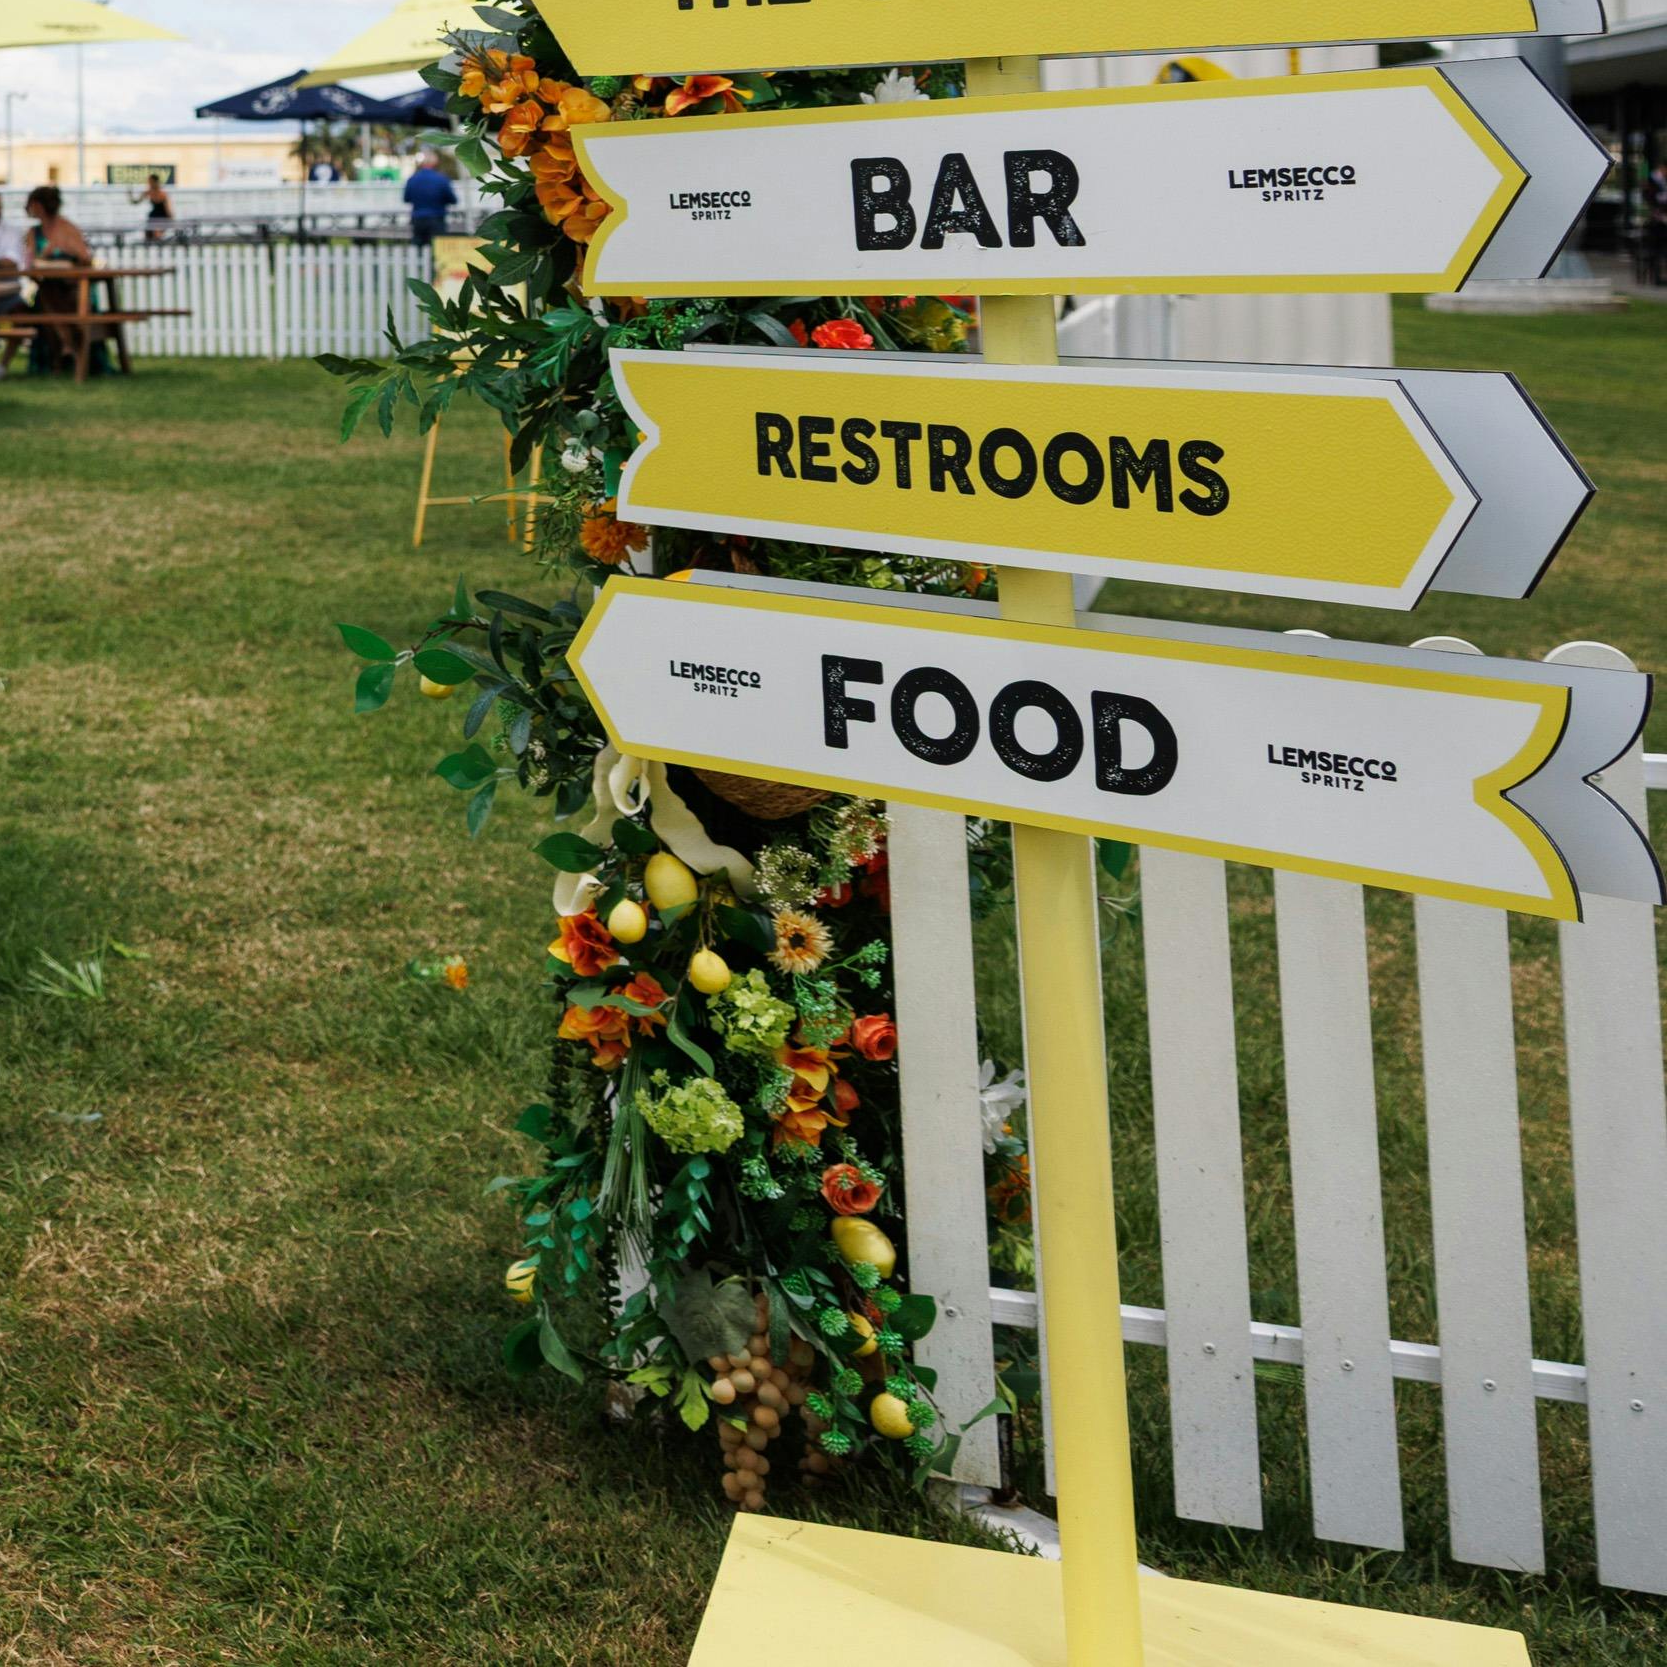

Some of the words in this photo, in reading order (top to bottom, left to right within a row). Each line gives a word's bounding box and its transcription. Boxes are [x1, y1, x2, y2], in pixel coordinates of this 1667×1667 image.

[850, 149, 1087, 252] BAR
[1262, 188, 1324, 202] SPRITZ
[691, 209, 731, 221] SPRITZ
[754, 411, 1230, 517] RESTROOMS
[693, 682, 738, 698] SPRITZ
[820, 653, 1179, 797] FOOD
[1301, 771, 1364, 792] SPRITZ
